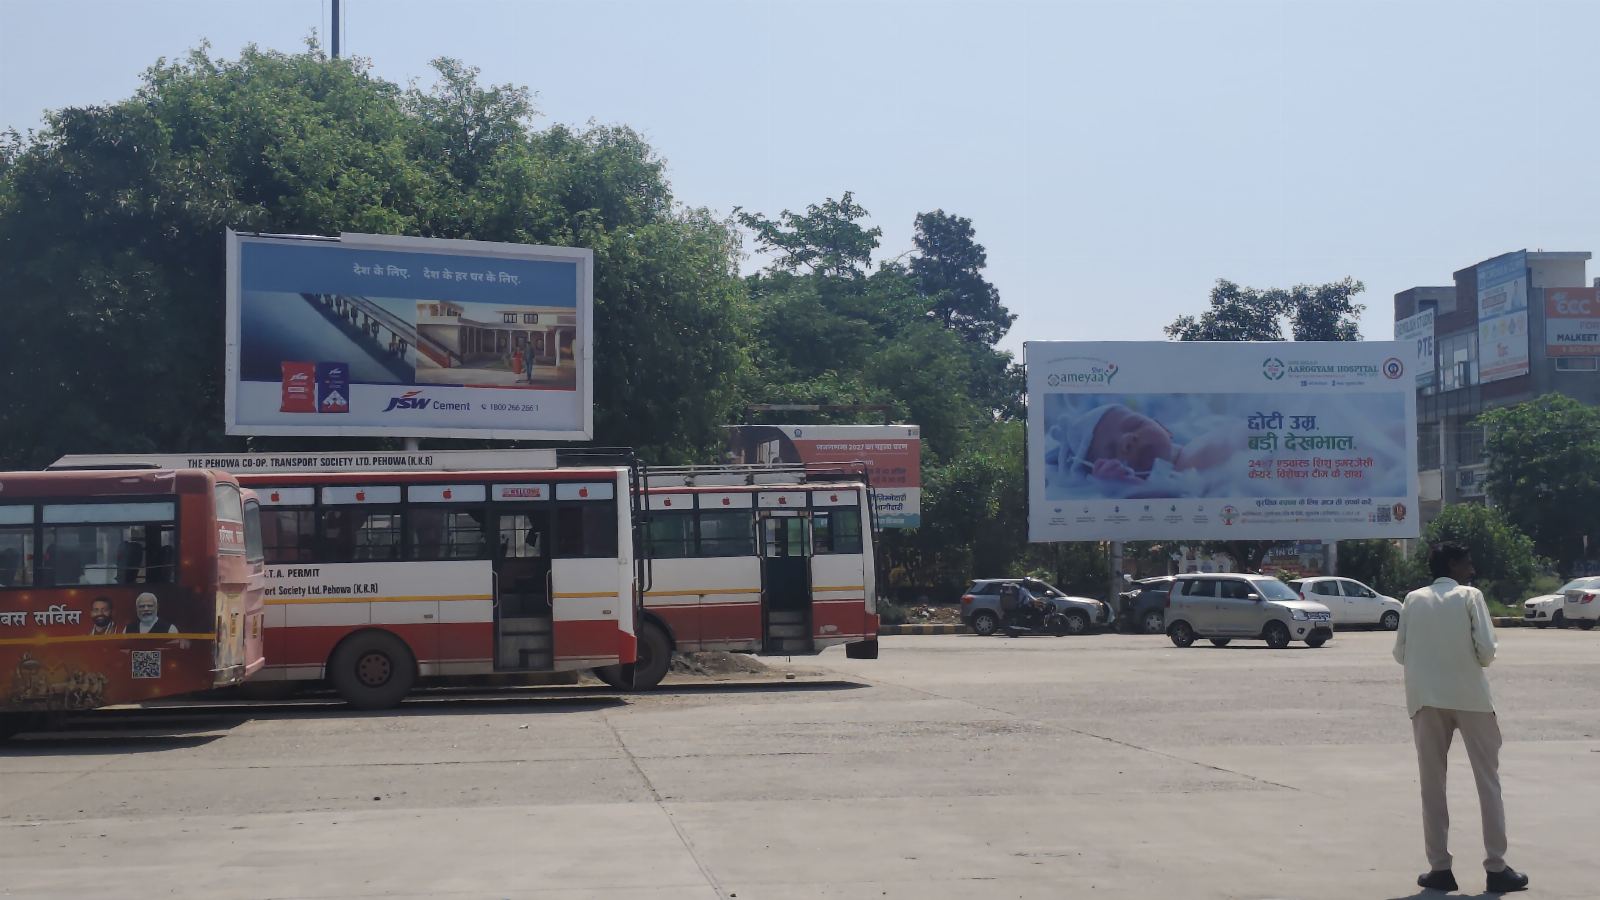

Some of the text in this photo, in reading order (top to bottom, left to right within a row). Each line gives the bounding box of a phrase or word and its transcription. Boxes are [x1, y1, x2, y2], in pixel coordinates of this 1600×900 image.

[353, 263, 370, 276] देश
[373, 264, 384, 276] के
[423, 267, 440, 280] देश
[442, 268, 453, 280] के
[455, 272, 467, 282] हर
[486, 271, 497, 283] के
[1557, 334, 1597, 342] MALKEET
[1417, 336, 1433, 360] PTE
[382, 390, 431, 412] JSW
[433, 401, 471, 411] Cement
[490, 403, 506, 411] 1800
[1248, 411, 1284, 430] छोटी
[1248, 432, 1278, 453] बड़ी
[188, 459, 203, 468] THE
[205, 459, 240, 468] PEHOWA
[242, 458, 268, 468] CO-OP.
[271, 457, 318, 467] TRANSPORT
[320, 457, 353, 467] SOCIETY
[355, 457, 371, 466] LTD.
[373, 456, 407, 466] PEHOWA
[287, 568, 320, 577] PERMIT
[279, 585, 306, 597] Society
[323, 583, 352, 594] Pehowa
[0, 604, 82, 626] बस सर्विस
